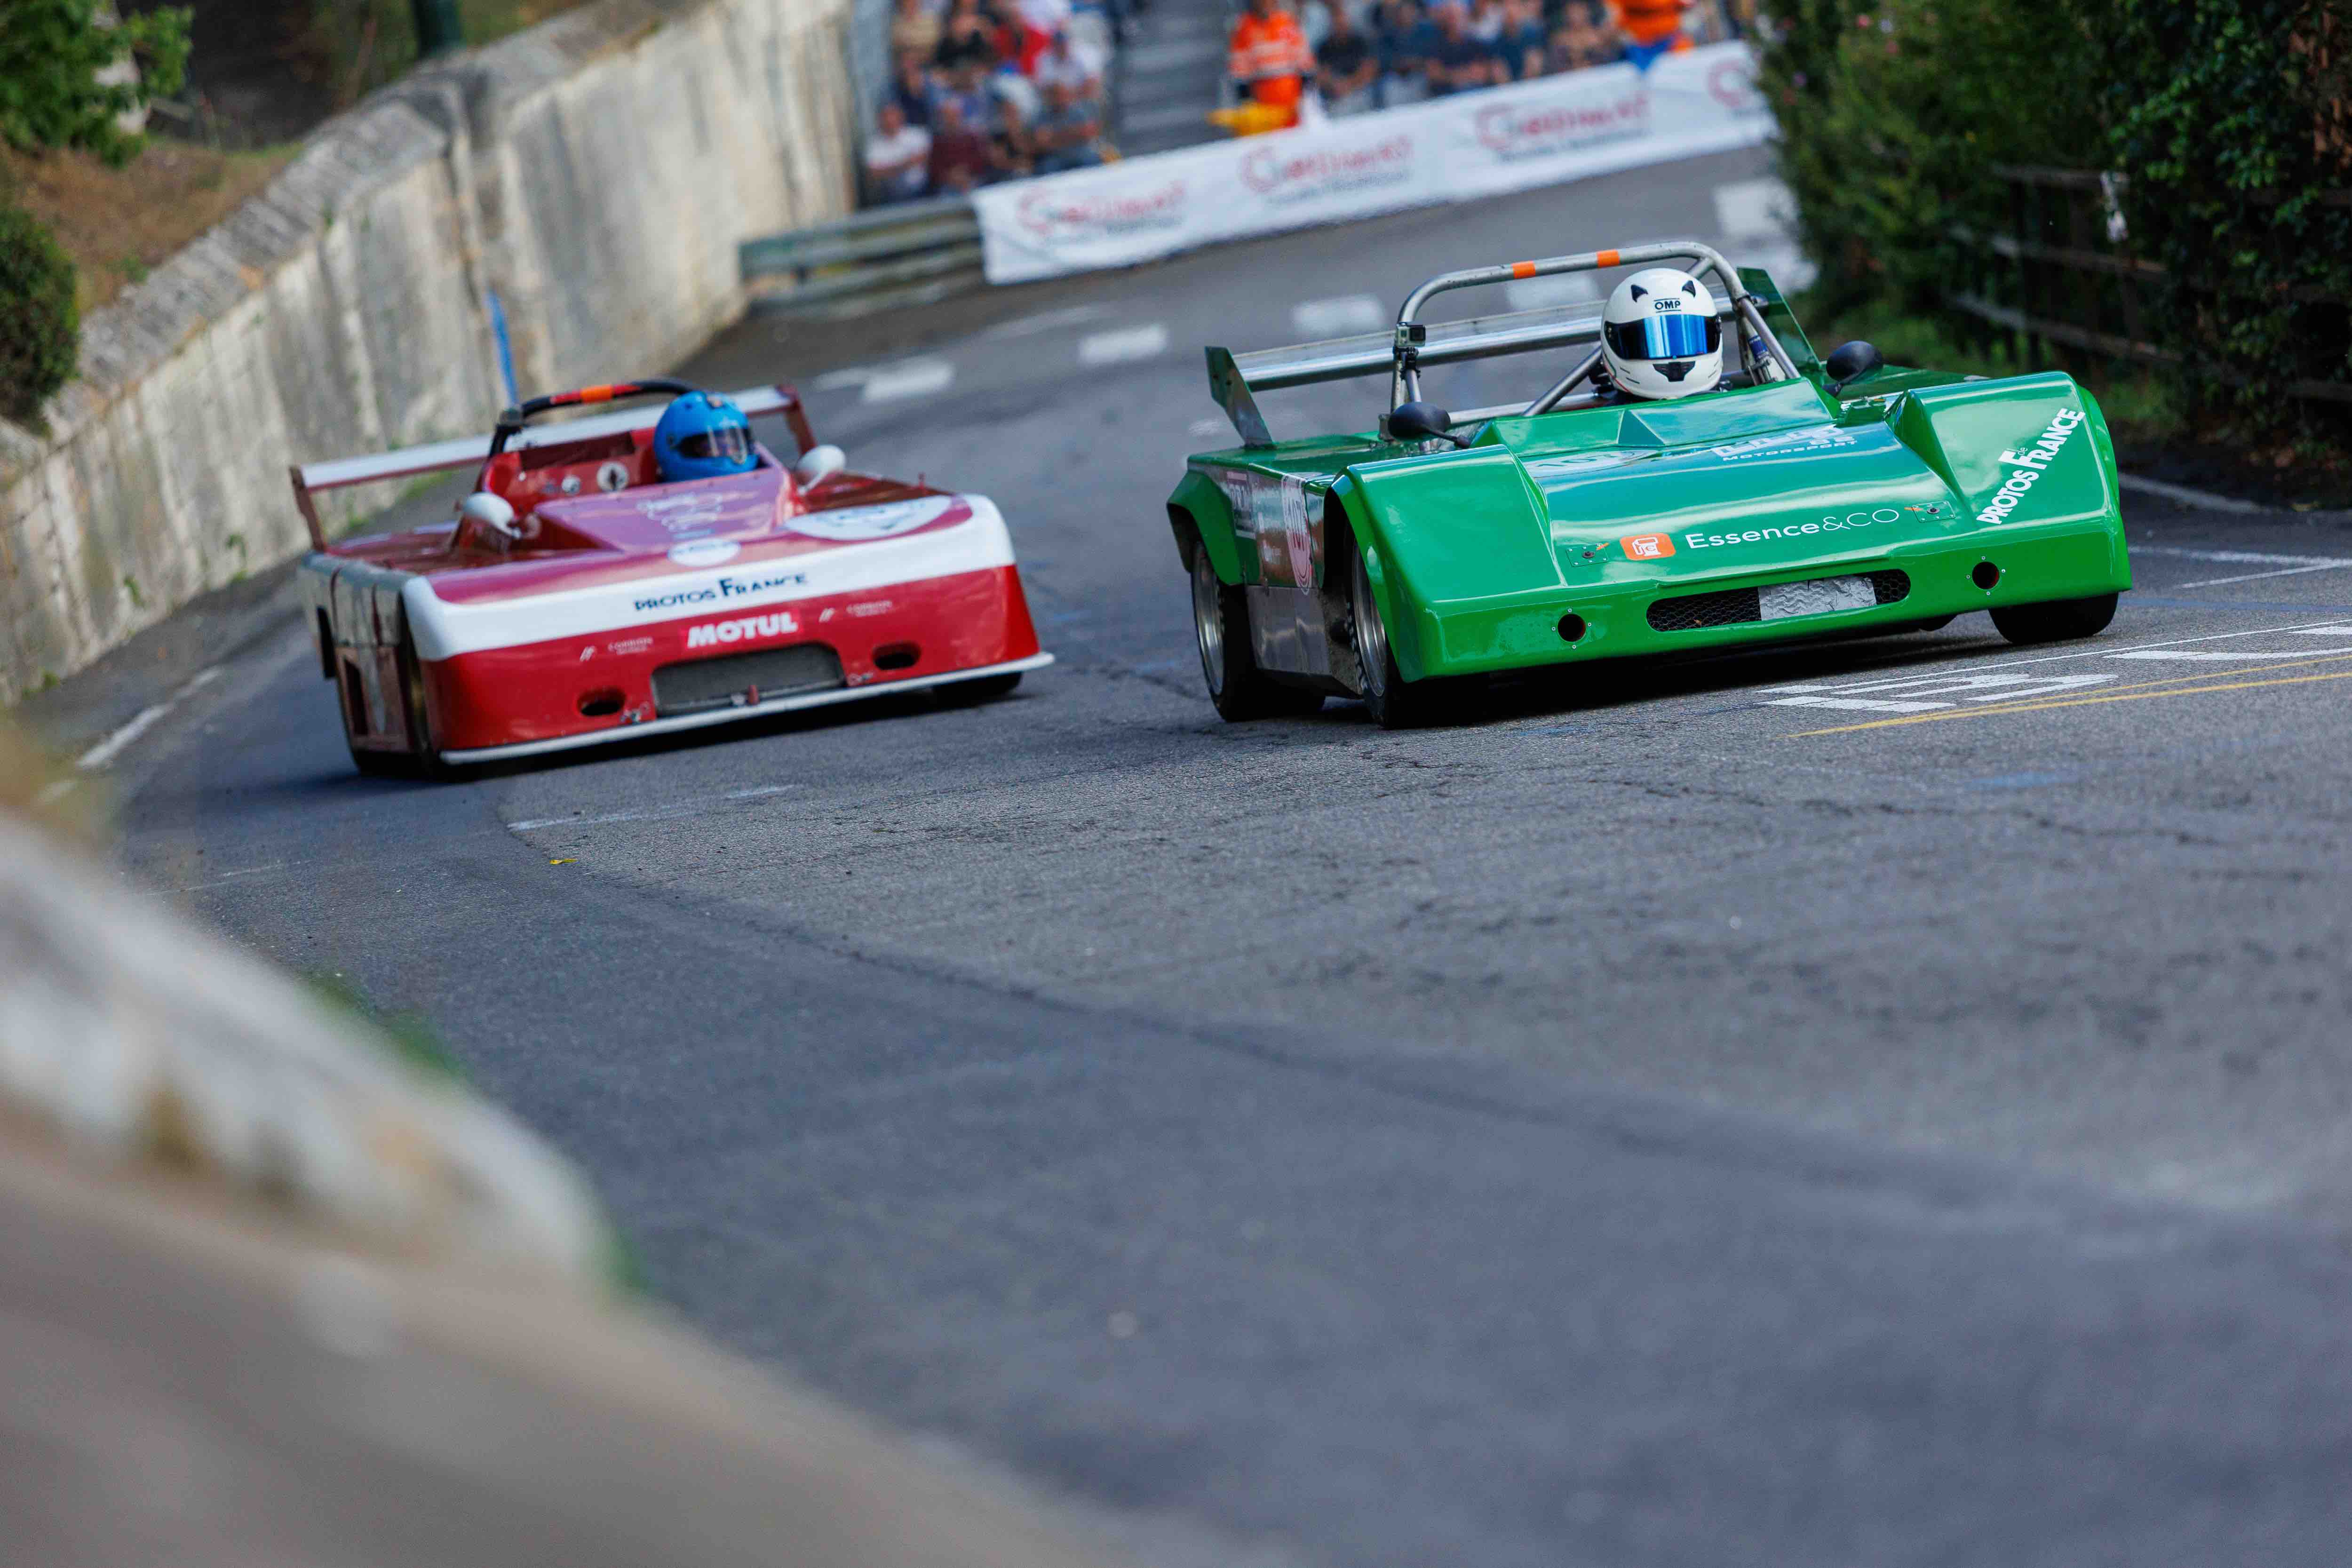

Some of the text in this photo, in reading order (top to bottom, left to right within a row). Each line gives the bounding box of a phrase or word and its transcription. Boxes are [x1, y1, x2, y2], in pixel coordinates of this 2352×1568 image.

[1655, 301, 1680, 310] OMP
[1723, 440, 1858, 461] MOTORSPORT
[1976, 408, 2085, 525] PROTOS FRANCE
[1685, 509, 1899, 549] Essence&CO
[633, 572, 807, 611] PROTOS FRANCE
[687, 612, 798, 648] MOTUL
